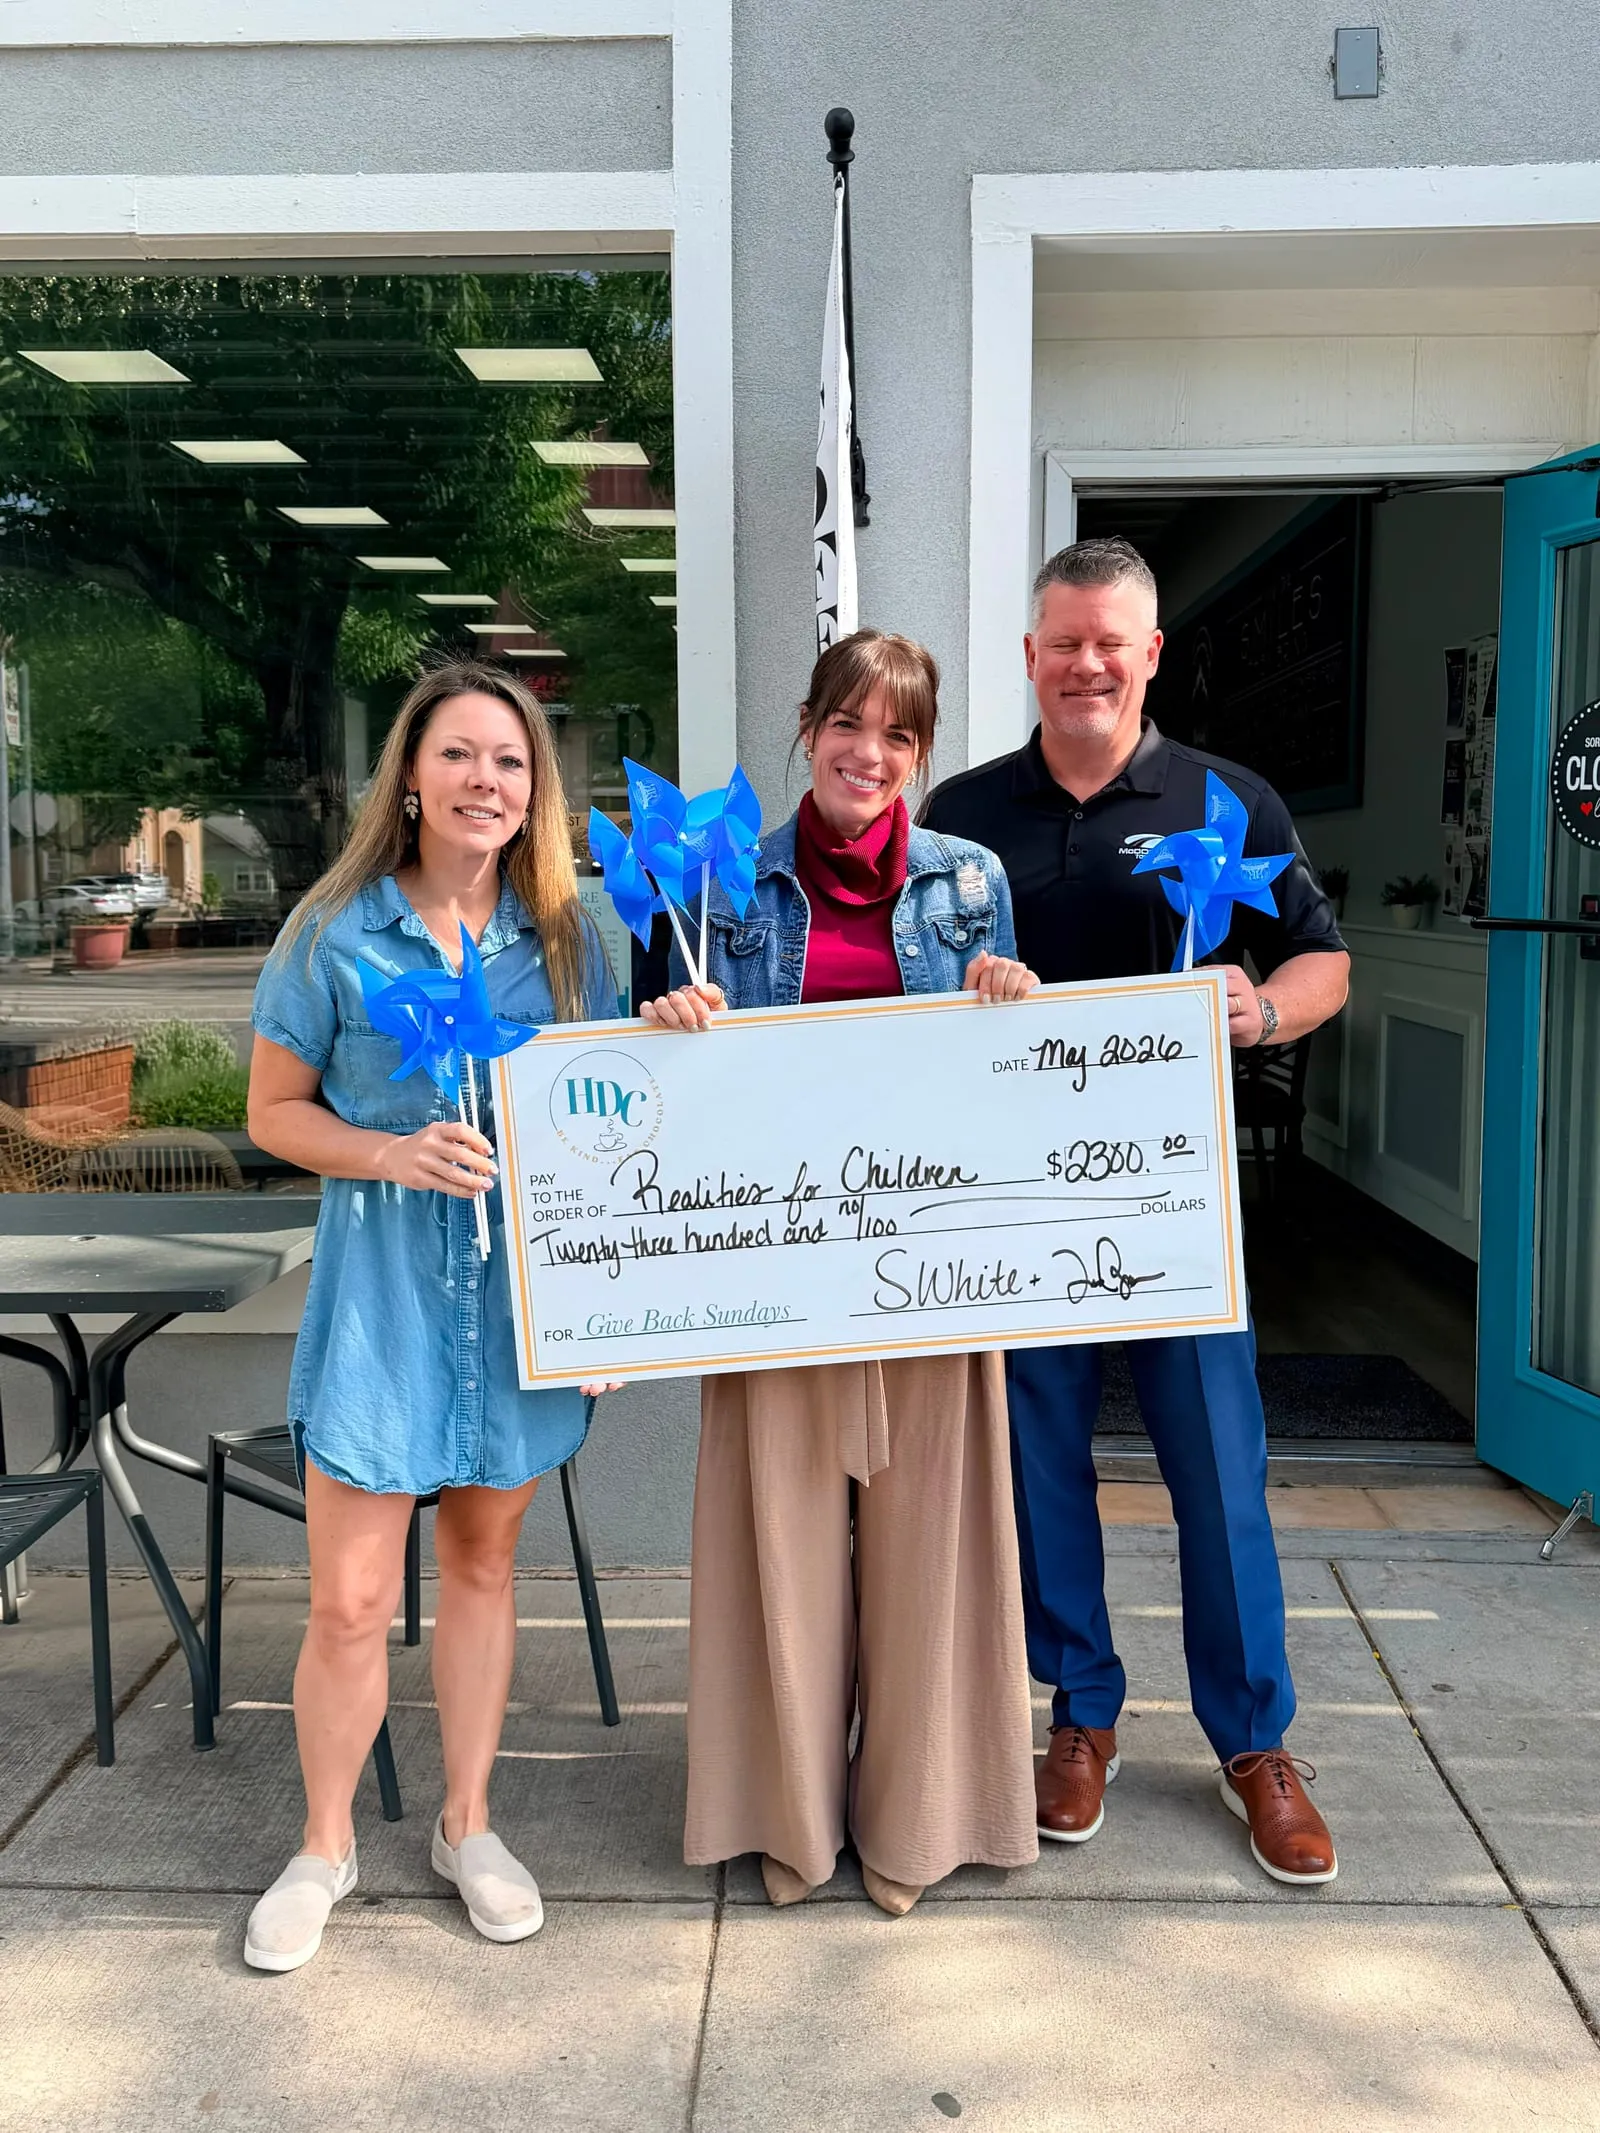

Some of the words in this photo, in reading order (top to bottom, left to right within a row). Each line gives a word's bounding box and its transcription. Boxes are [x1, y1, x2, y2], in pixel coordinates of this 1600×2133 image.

[1585, 737, 1600, 748] SOR
[1566, 755, 1600, 791] CLO
[992, 1058, 1029, 1073] DATE
[1029, 1038, 1087, 1092] May
[1099, 1034, 1183, 1067] 2026
[564, 1076, 647, 1128] HDC
[529, 1172, 556, 1187] PAY
[610, 1149, 774, 1215] Realities
[782, 1160, 821, 1226] for
[841, 1145, 979, 1194] Children
[531, 1190, 552, 1205] TO
[554, 1188, 584, 1203] THE
[533, 1207, 584, 1223] ORDER
[587, 1204, 607, 1218] OF
[1140, 1198, 1206, 1215] DOLLARS
[684, 1218, 773, 1253] hundred
[783, 1217, 829, 1244] and
[586, 1312, 634, 1337] Give
[642, 1305, 695, 1333] Back
[703, 1299, 791, 1328] Sundays
[543, 1329, 574, 1343] FOR
